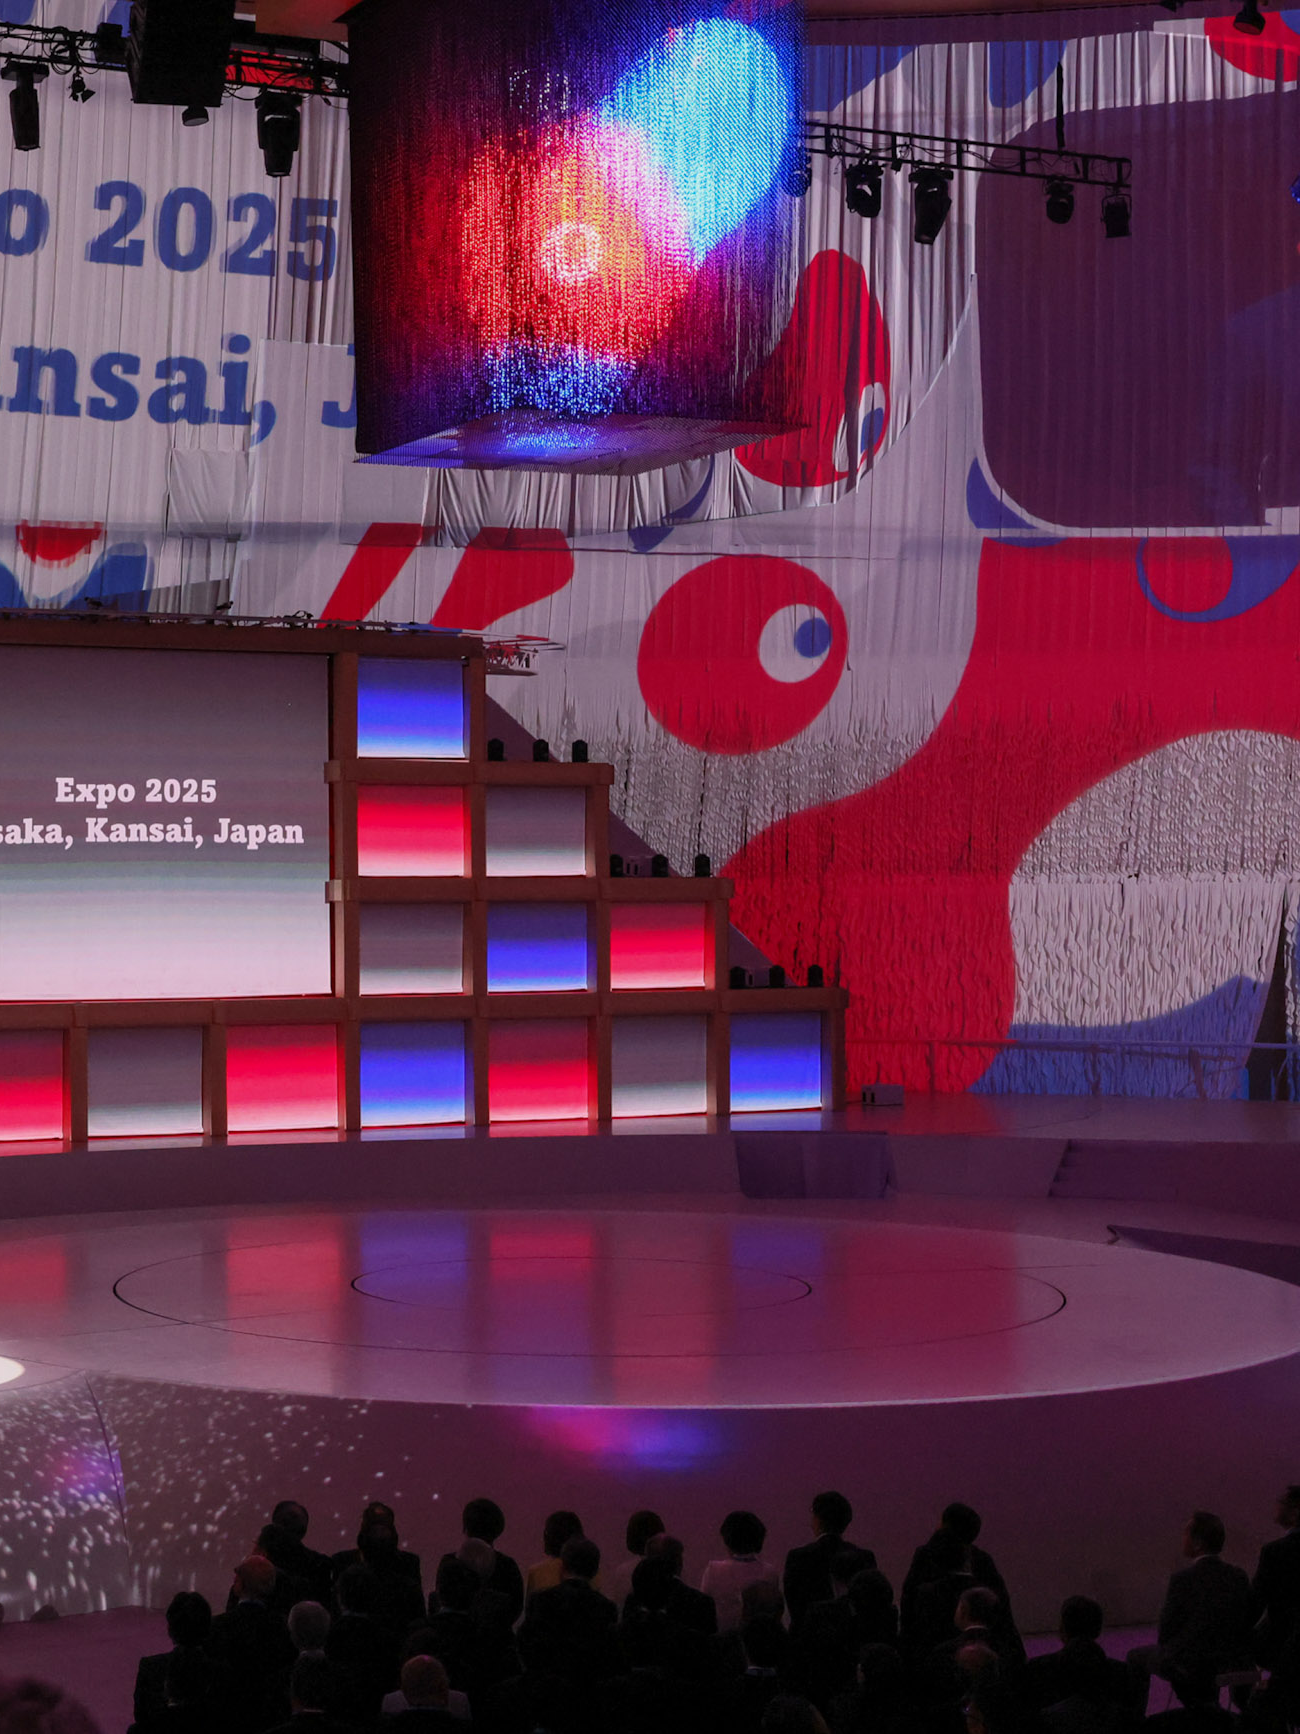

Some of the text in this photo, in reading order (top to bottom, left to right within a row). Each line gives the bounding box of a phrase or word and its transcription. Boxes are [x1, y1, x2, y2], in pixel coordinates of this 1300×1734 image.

[86, 180, 338, 282] 2025
[55, 776, 217, 809] Expo 2025
[85, 816, 204, 849] Kansai,
[214, 818, 304, 850] Japan
